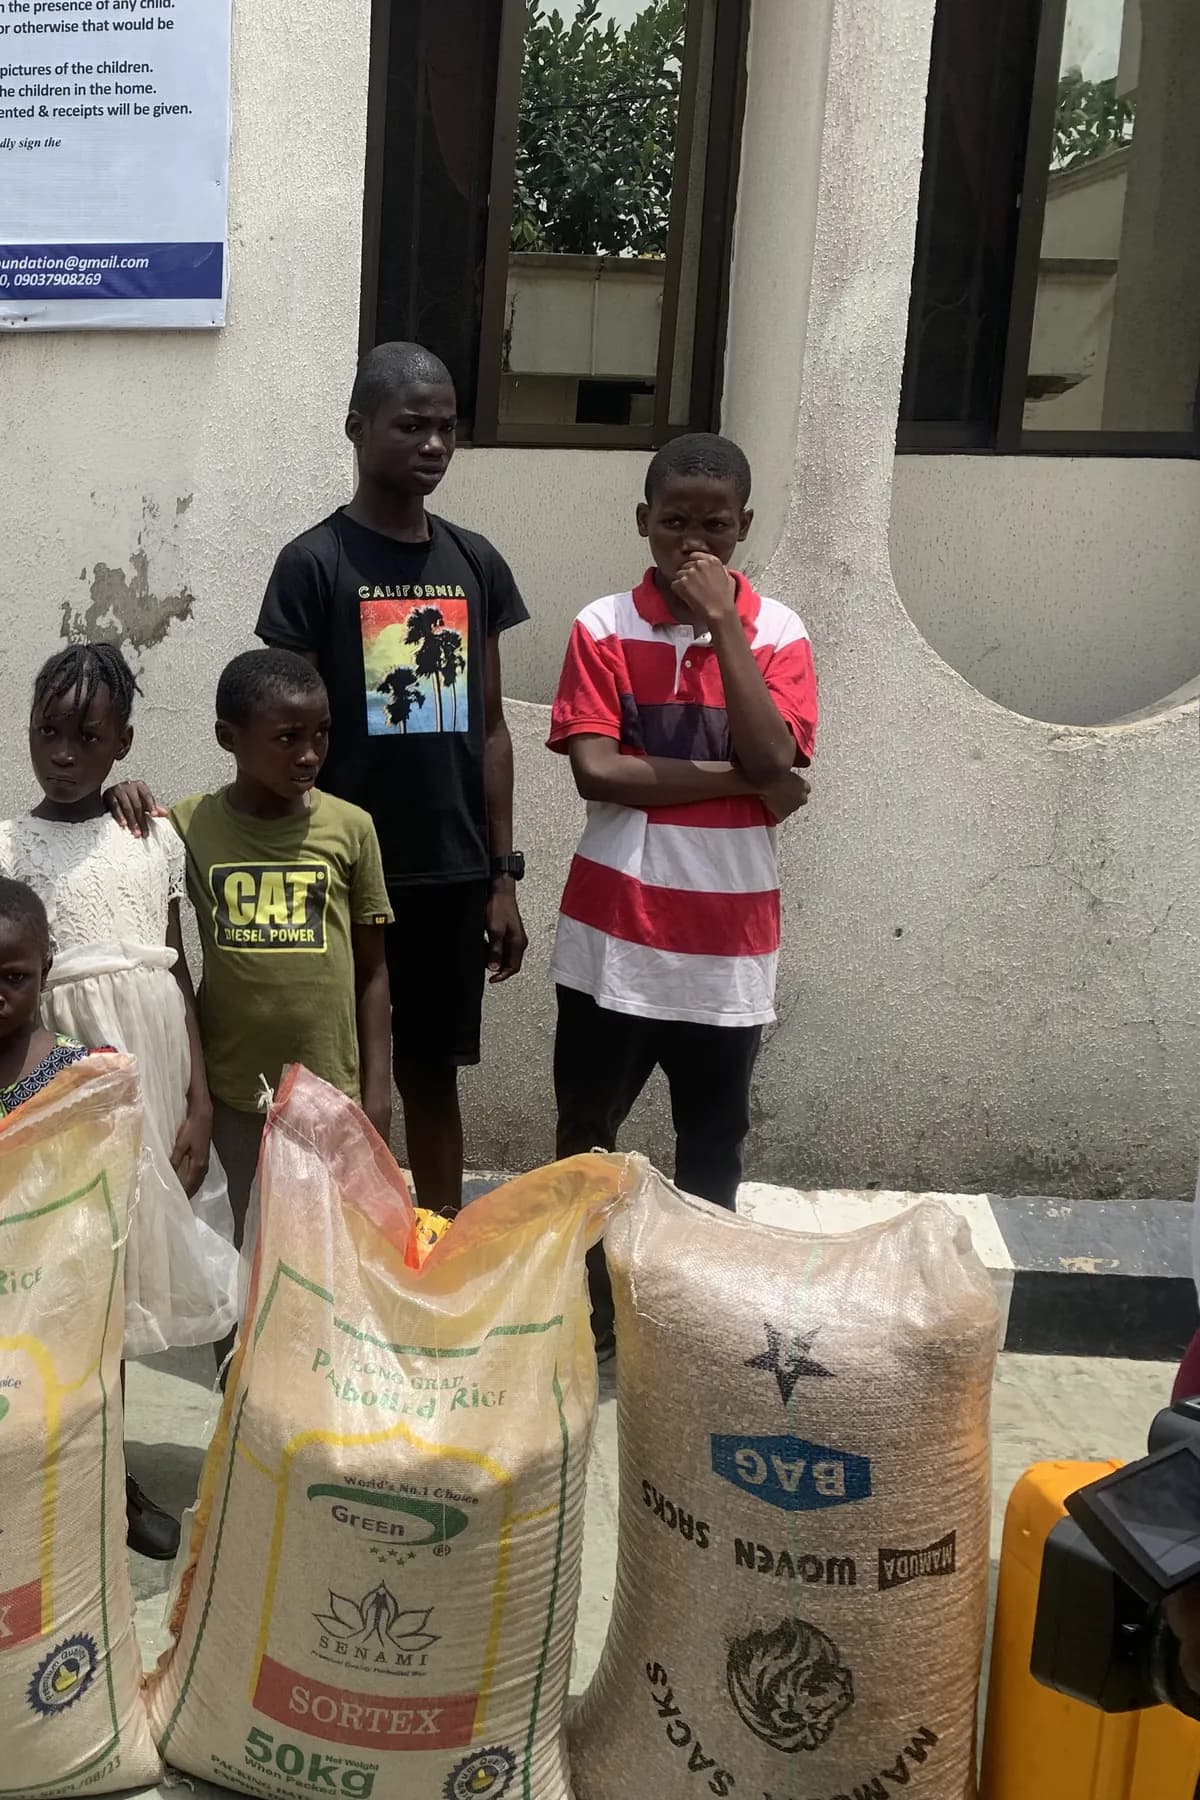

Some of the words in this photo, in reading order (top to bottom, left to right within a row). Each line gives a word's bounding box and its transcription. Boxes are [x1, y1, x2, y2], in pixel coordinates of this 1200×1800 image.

[7, 0, 30, 13] the
[33, 0, 92, 15] presence
[95, 0, 110, 10] of
[112, 0, 137, 12] any
[13, 19, 79, 34] otherwise
[81, 18, 110, 32] that
[112, 16, 154, 31] would
[157, 16, 174, 30] be
[0, 63, 52, 80] pictures
[54, 61, 69, 75] of
[70, 61, 93, 75] the
[96, 60, 153, 74] children.
[18, 83, 71, 97] children
[74, 82, 86, 96] in
[88, 82, 112, 95] the
[114, 81, 156, 95] home.
[38, 104, 50, 117] &
[52, 103, 104, 119] receipts
[106, 102, 130, 116] will
[133, 102, 150, 115] be
[152, 102, 192, 118] given.
[19, 138, 41, 150] sign
[44, 137, 62, 148] the
[14, 273, 102, 286] 09037908269
[358, 584, 465, 599] CALIFORNIA
[224, 871, 316, 926] CAT
[224, 929, 266, 943] DIESEL
[269, 929, 315, 943] POWER
[735, 1447, 845, 1498] BAG
[641, 1479, 711, 1550] SACKS
[734, 1538, 856, 1585] WOVEN
[881, 1544, 954, 1584] MAMUDA
[318, 1635, 429, 1667] SENAMI
[289, 1686, 445, 1736] SORTEX
[646, 1662, 736, 1797] SACKS
[243, 1726, 377, 1800] 50kg
